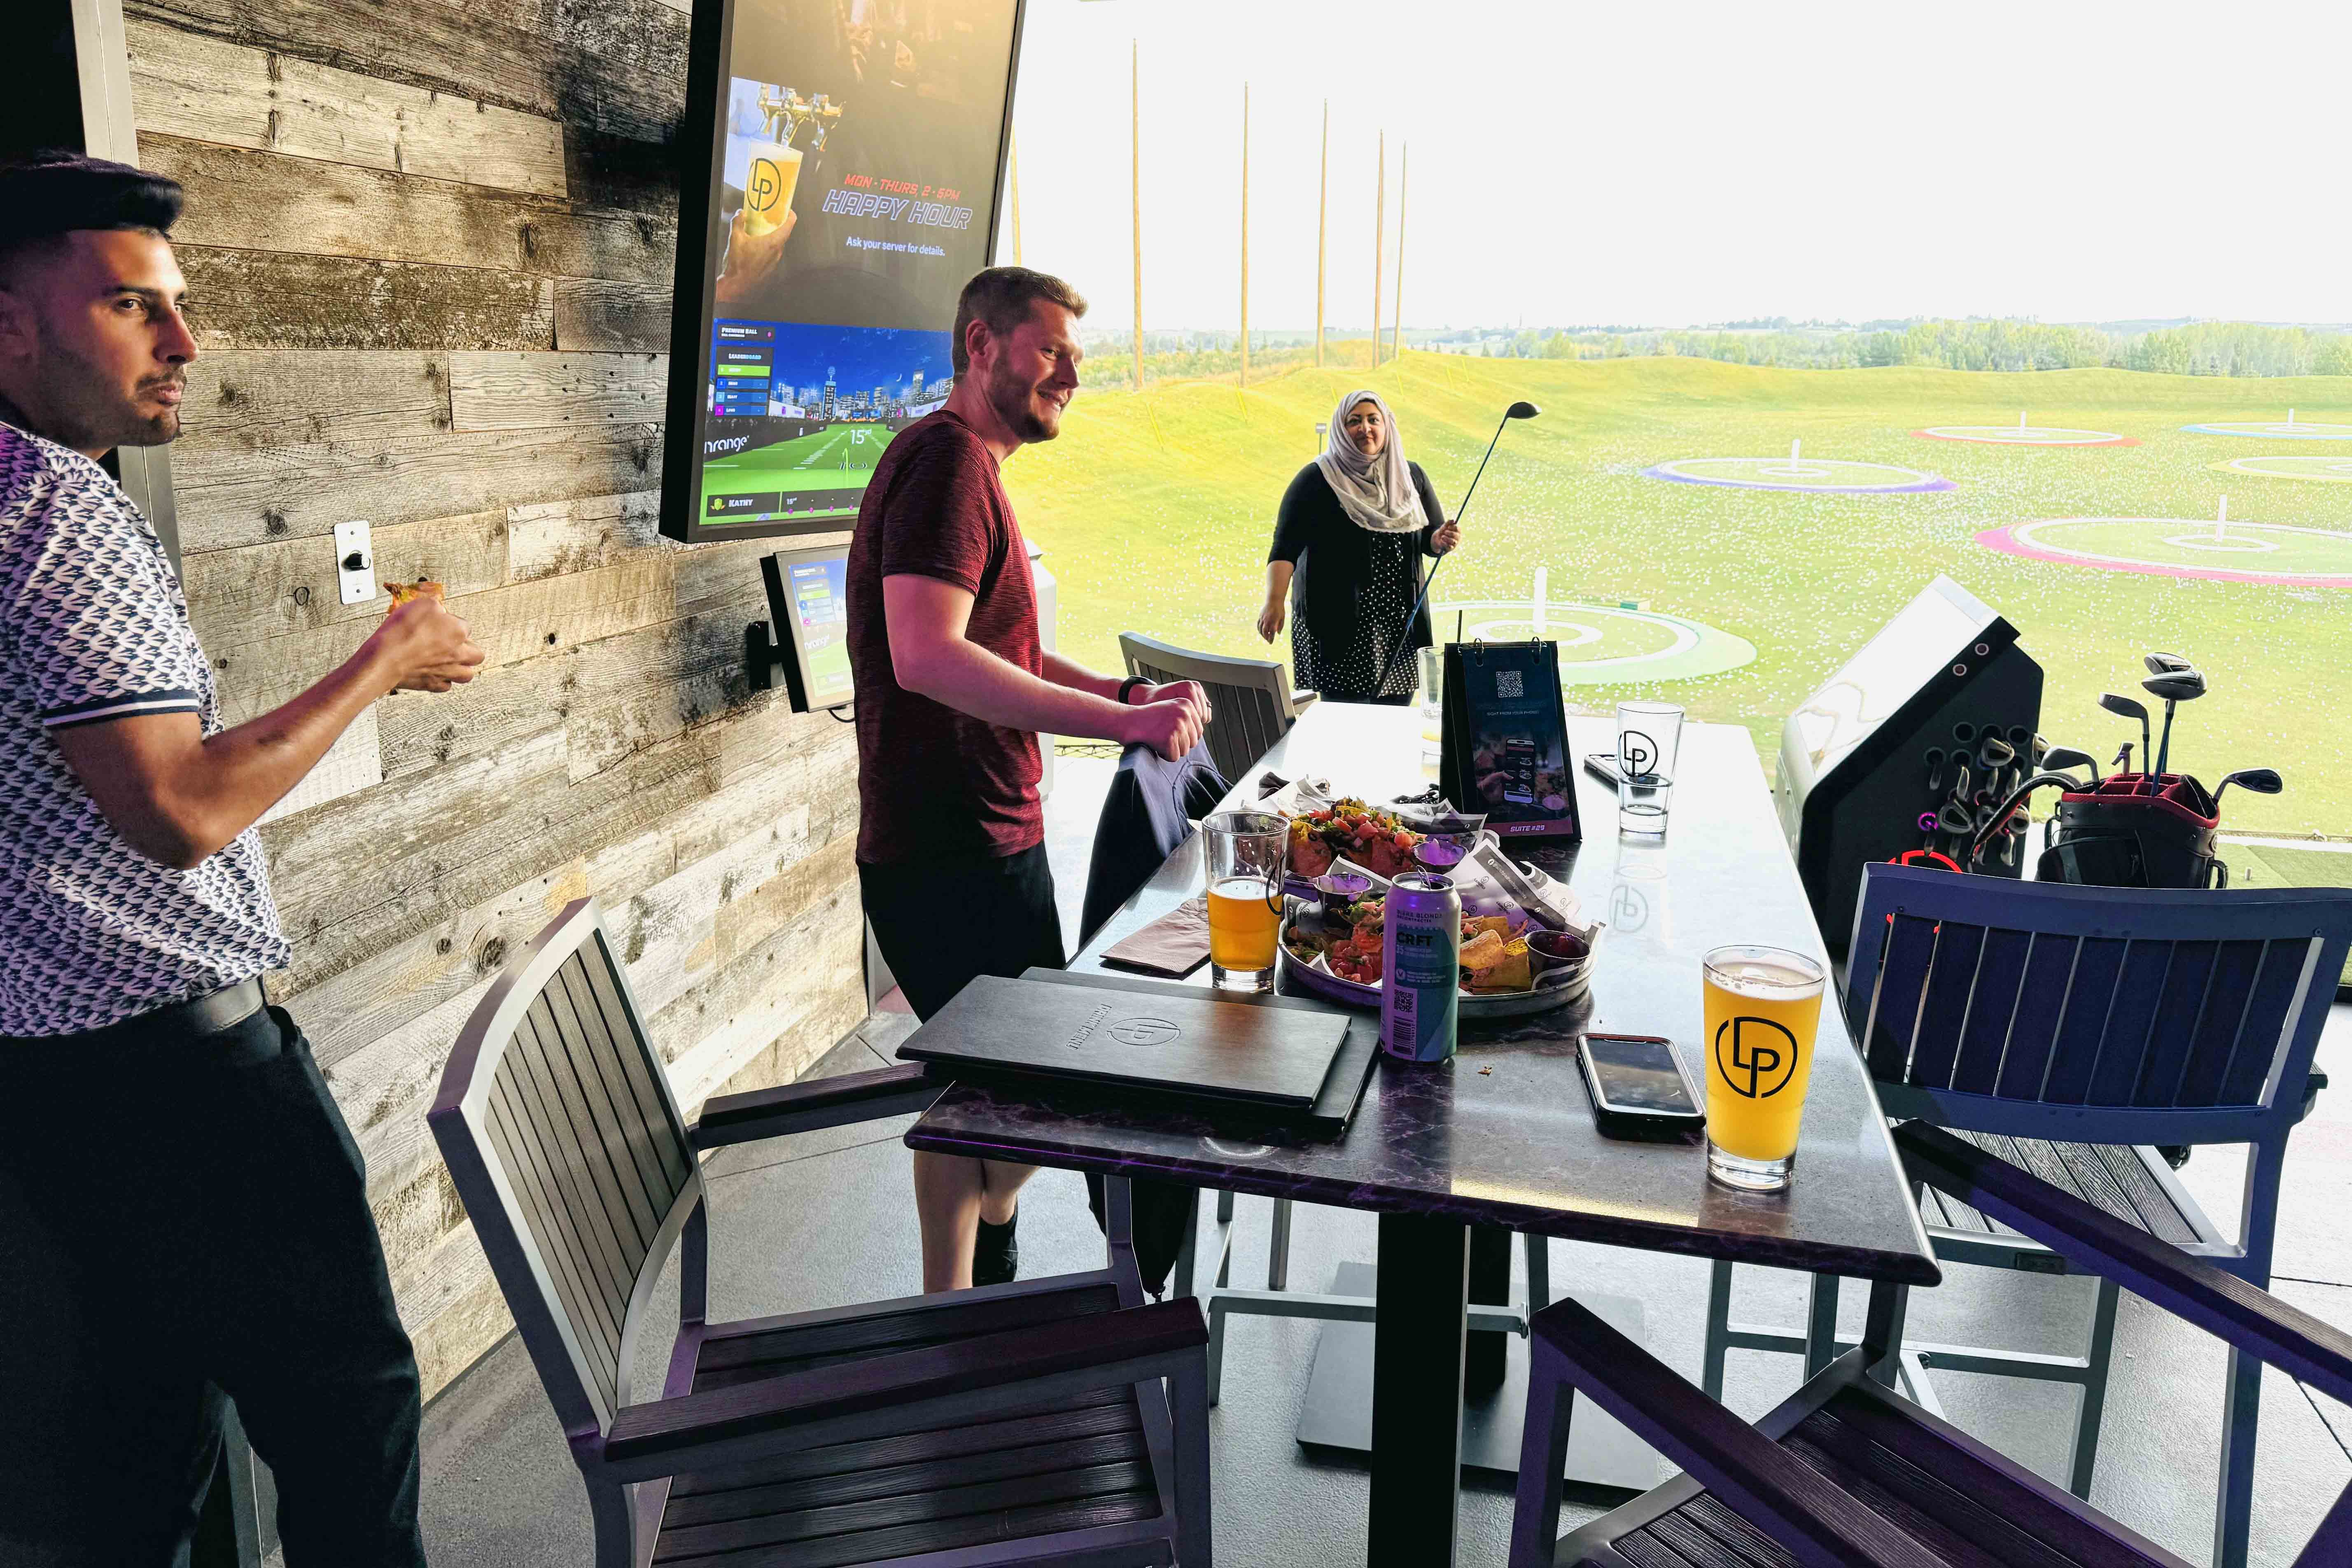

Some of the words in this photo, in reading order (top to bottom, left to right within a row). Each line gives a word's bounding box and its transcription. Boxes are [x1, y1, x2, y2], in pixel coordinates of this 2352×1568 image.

[844, 174, 873, 188] MON
[880, 179, 918, 198] THURS,
[922, 186, 931, 197] 2
[822, 189, 909, 221] HAPPY
[908, 201, 973, 229] HOUR
[846, 236, 862, 247] Ask
[863, 239, 881, 250] your
[882, 241, 907, 252] server
[907, 243, 918, 254] for
[919, 245, 945, 256] details.
[728, 499, 754, 507] KATHY
[1086, 1003, 1112, 1027] DRINK
[1065, 1025, 1094, 1051] MENU
[1715, 1016, 1798, 1099] LP
